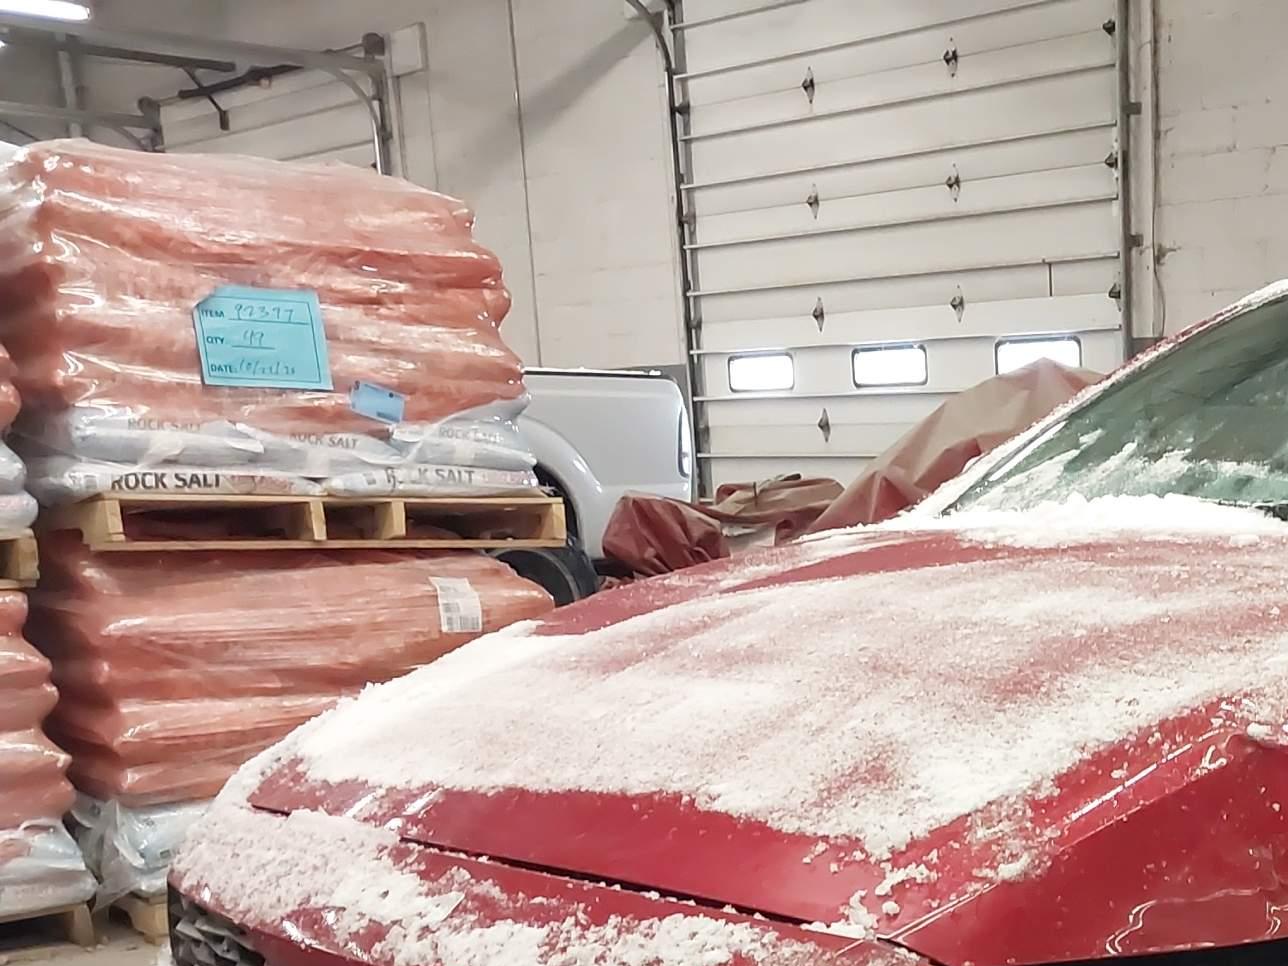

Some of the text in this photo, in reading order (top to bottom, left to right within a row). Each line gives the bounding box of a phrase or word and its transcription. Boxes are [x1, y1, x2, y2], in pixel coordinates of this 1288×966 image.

[201, 308, 225, 318] ITEM
[327, 435, 358, 450] SALT
[111, 471, 168, 490] ROCK
[384, 466, 428, 488] RK
[434, 468, 475, 484] SALT
